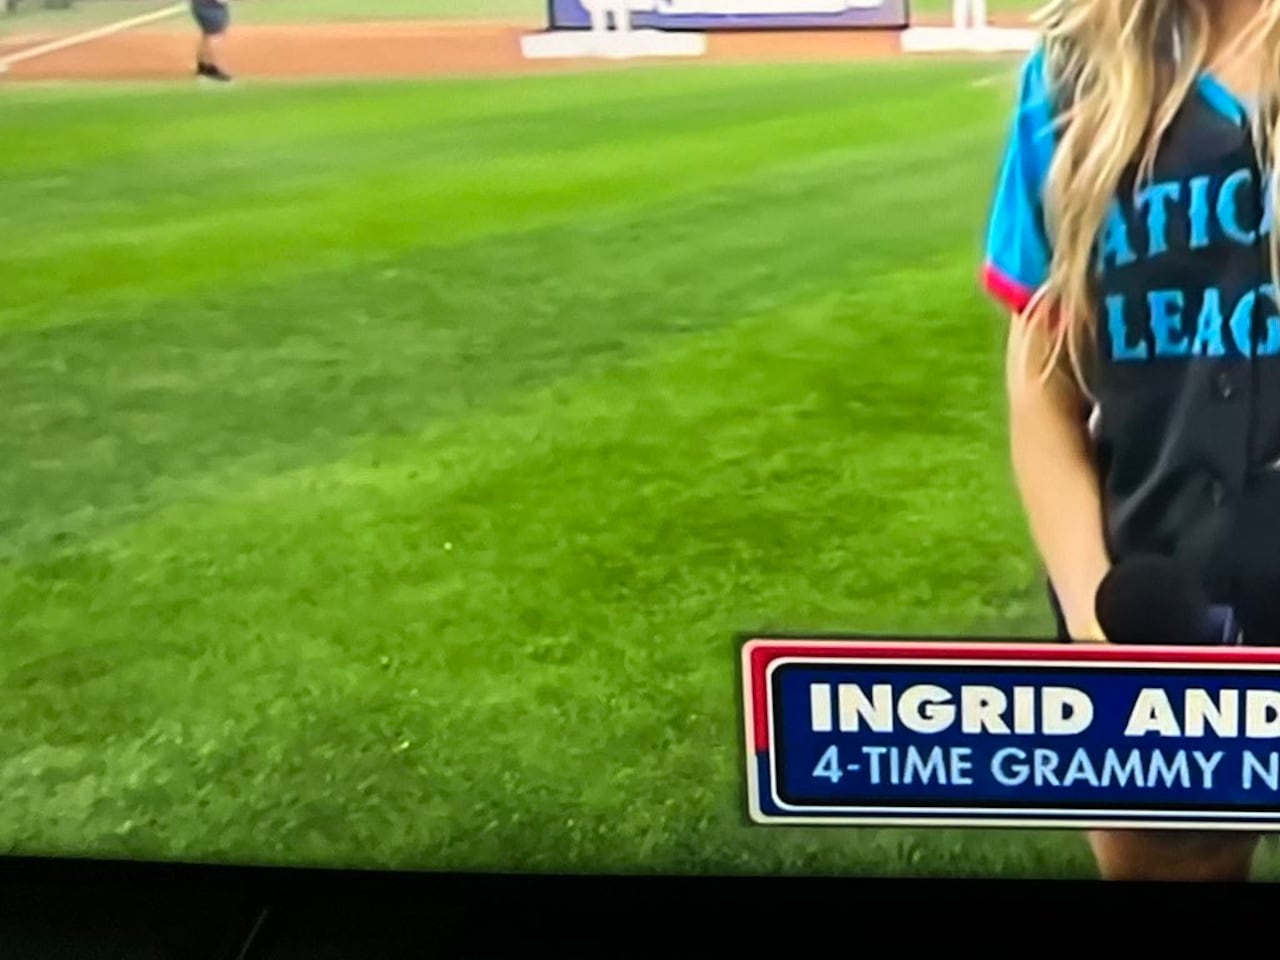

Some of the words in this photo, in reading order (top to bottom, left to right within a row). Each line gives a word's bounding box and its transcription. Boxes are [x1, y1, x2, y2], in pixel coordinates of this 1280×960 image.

[810, 682, 1094, 736] INGRID
[810, 744, 973, 786] 4-TIME
[990, 746, 1224, 790] GRAMMY
